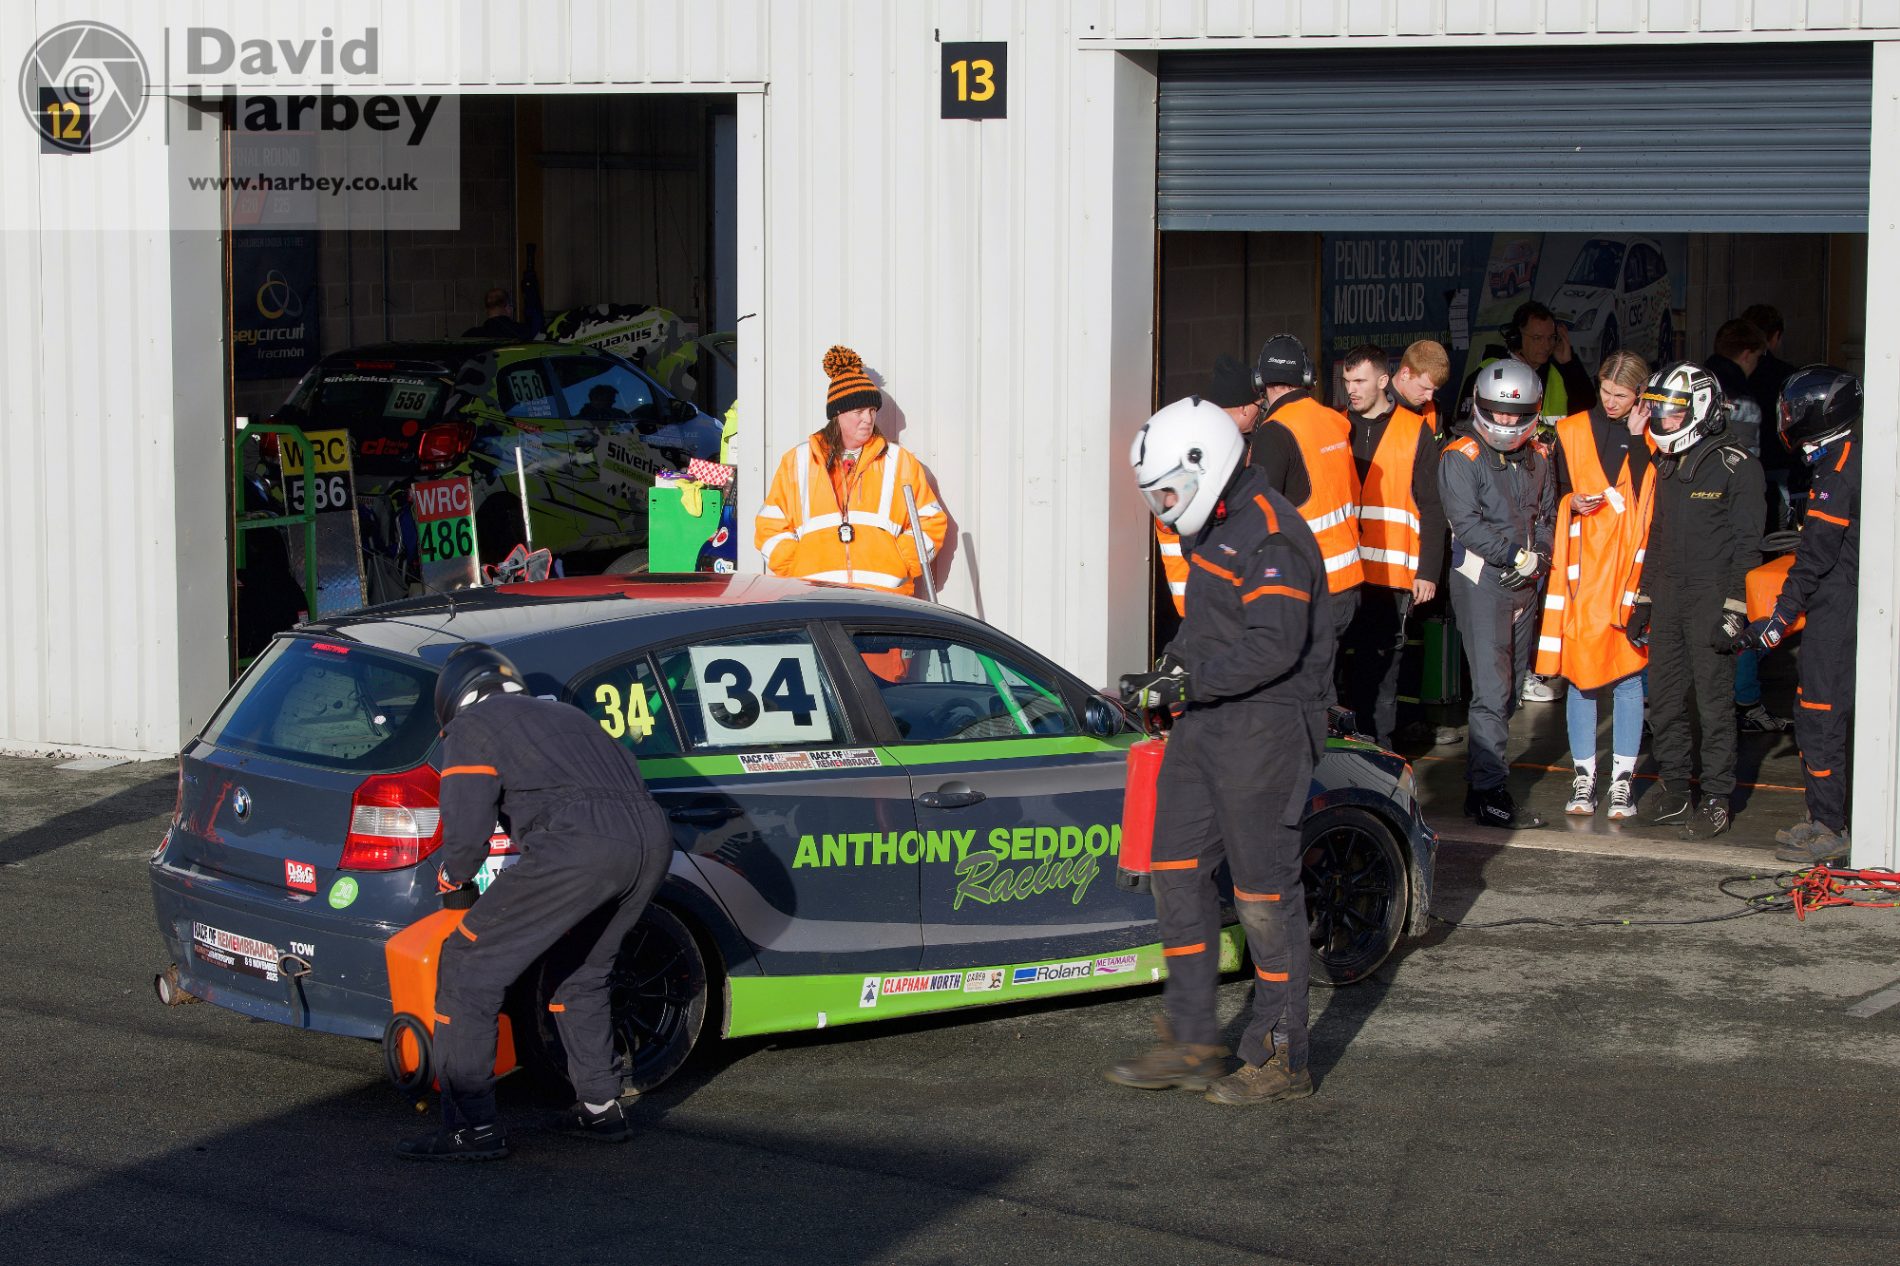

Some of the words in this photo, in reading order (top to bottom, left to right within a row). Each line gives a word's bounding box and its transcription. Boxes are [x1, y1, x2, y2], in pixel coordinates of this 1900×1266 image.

[950, 59, 996, 102] 13
[47, 101, 82, 140] 12
[1335, 240, 1386, 280] PENDLE
[1389, 239, 1400, 279] &
[1403, 238, 1465, 279] DISTRICT
[1334, 283, 1386, 325] MOTOR
[1388, 282, 1425, 322] CLUB
[393, 391, 428, 411] 558
[511, 374, 545, 402] 558
[283, 437, 346, 468] WRC
[292, 475, 347, 512] 586
[415, 483, 468, 516] WRC
[420, 517, 474, 562] 486
[703, 656, 819, 730] 34
[595, 682, 656, 739] 34
[746, 760, 813, 772] REMEMBRANCE
[810, 751, 833, 761] RACE
[816, 757, 881, 769] REMEMBRANCE
[791, 829, 976, 869] ANTHONY
[953, 849, 1100, 911] Racing
[217, 930, 278, 962] REMEMBRANCE
[289, 941, 316, 957] TOW
[1095, 954, 1137, 968] METAMARK
[883, 976, 930, 994] CLAPHAM
[929, 973, 962, 991] NORTH
[1036, 961, 1093, 981] Roland
